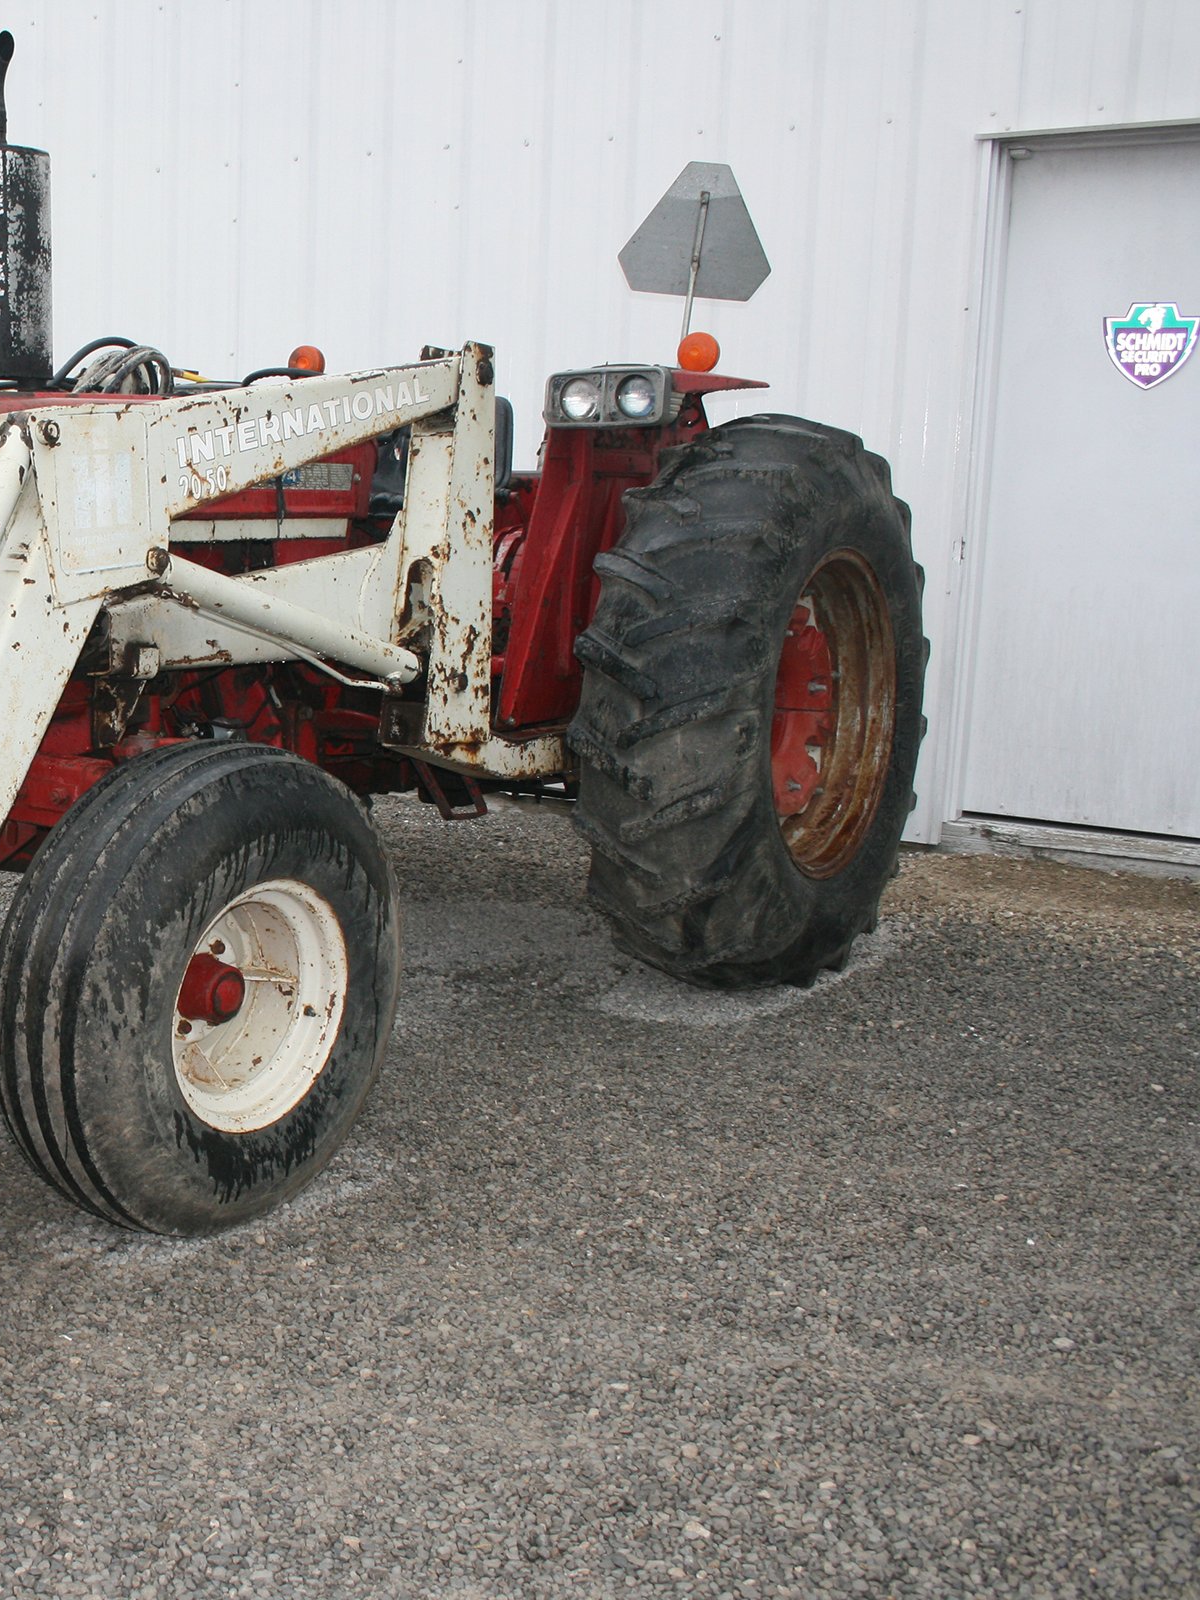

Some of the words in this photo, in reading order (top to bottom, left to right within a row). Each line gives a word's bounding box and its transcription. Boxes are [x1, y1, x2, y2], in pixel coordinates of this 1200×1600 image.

[1116, 332, 1187, 351] SCHMIDT
[1120, 350, 1178, 363] SECURITY
[1134, 363, 1161, 377] PRO
[177, 378, 430, 468] INTERNATIONAL
